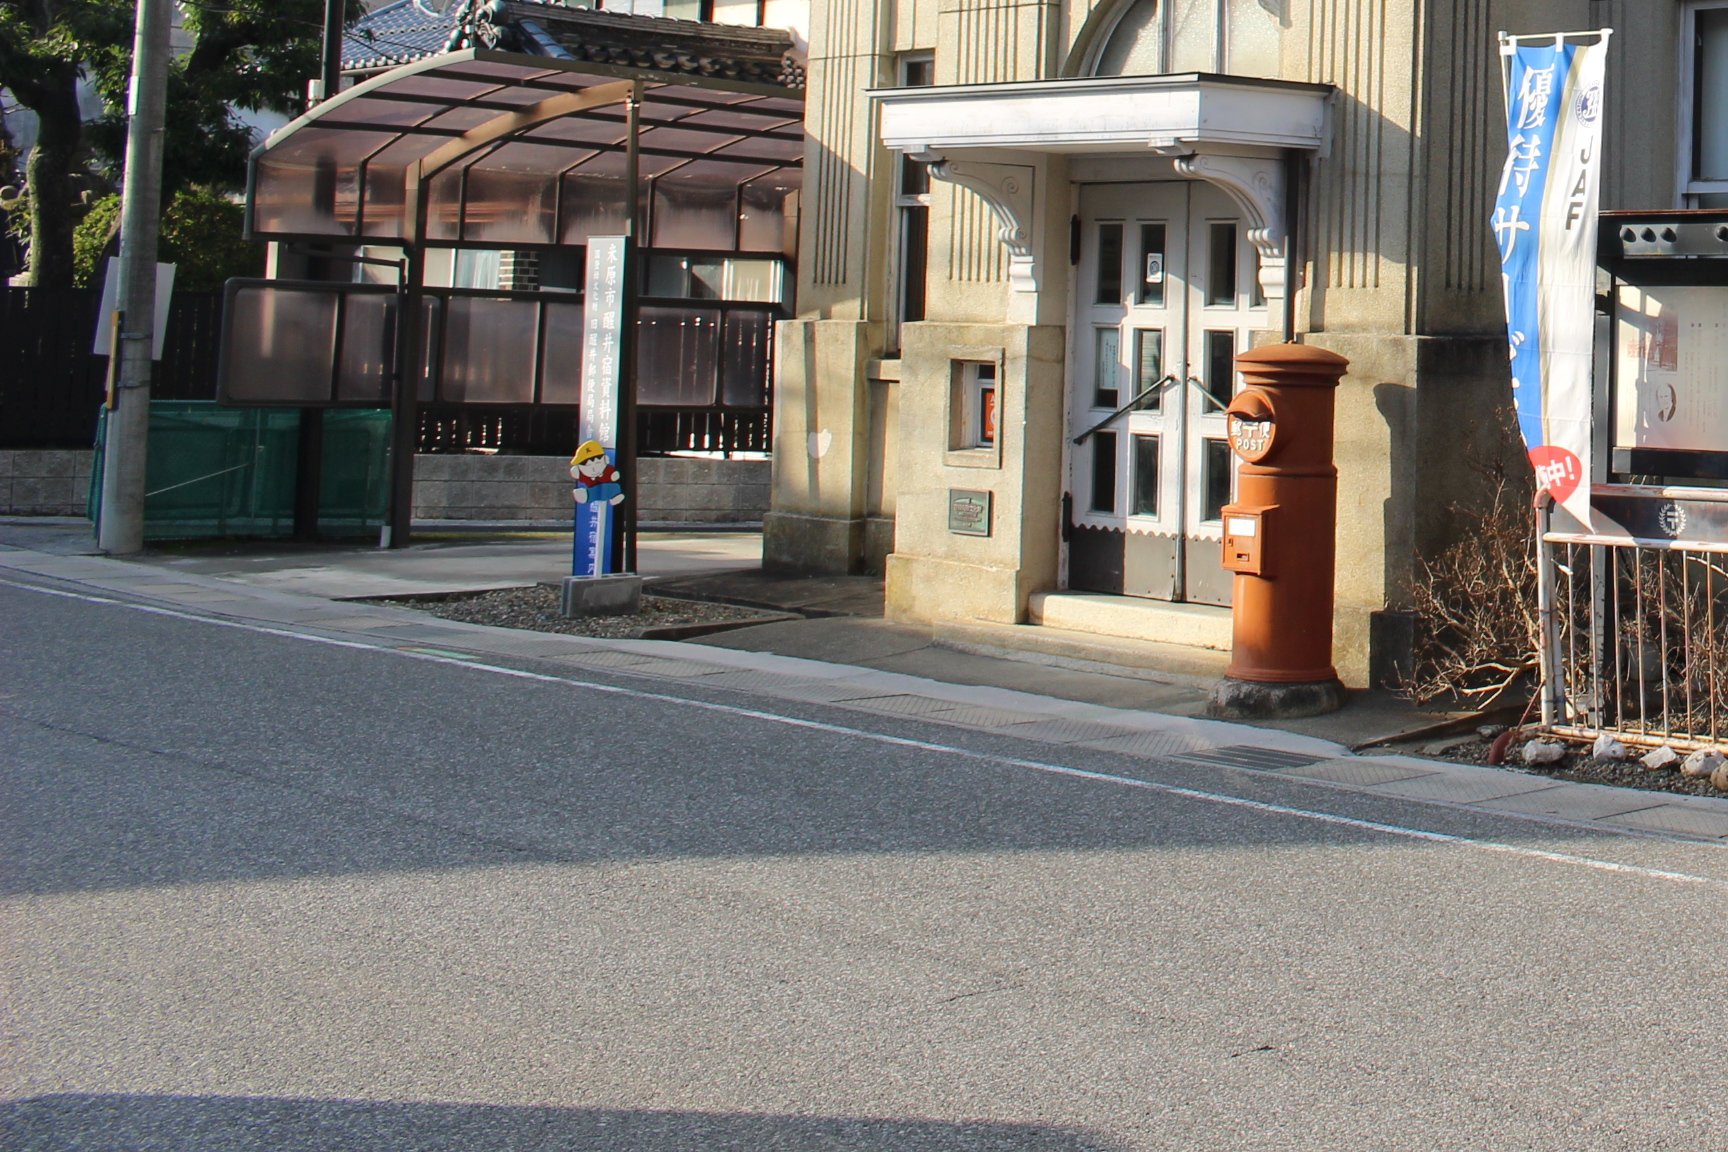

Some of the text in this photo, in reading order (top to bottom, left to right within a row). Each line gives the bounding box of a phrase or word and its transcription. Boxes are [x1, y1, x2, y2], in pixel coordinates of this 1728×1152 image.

[1565, 134, 1594, 231] JAF
[598, 242, 618, 443] 米原市醒井宿資料館
[1236, 438, 1265, 452] POST
